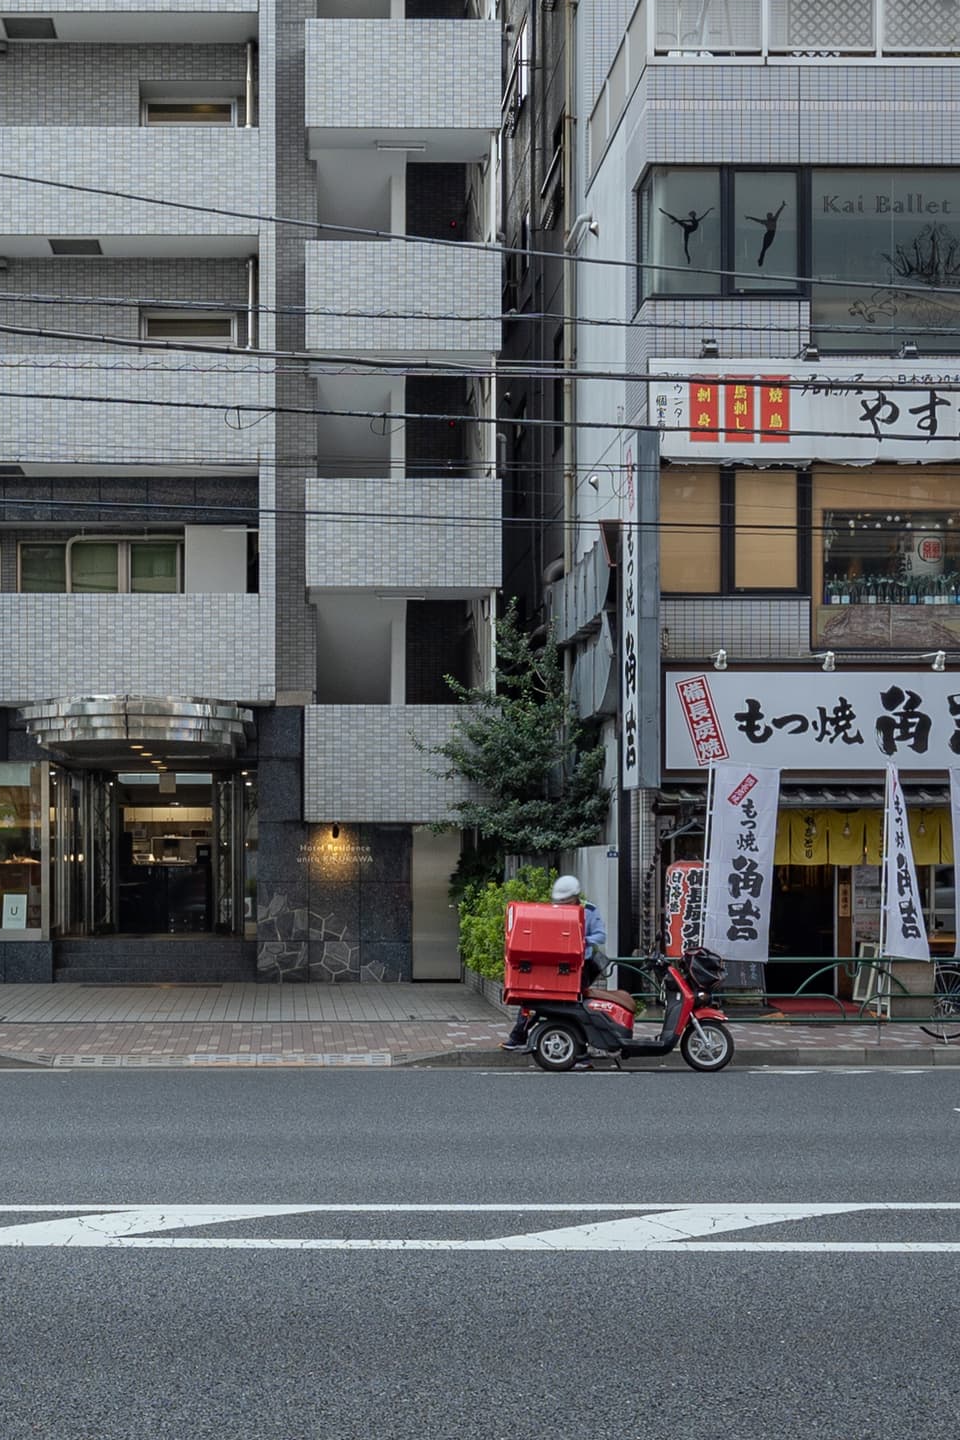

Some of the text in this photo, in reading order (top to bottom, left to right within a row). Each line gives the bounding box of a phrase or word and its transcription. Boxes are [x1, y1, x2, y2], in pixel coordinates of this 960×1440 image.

[823, 193, 952, 214] Kai Ballet
[673, 372, 684, 428] ウンター
[898, 374, 960, 385] 日本酒20
[859, 389, 960, 443] やす
[683, 681, 724, 760] 備長炭焼
[734, 685, 960, 755] もつ焼 角
[737, 799, 759, 852] もつ焼
